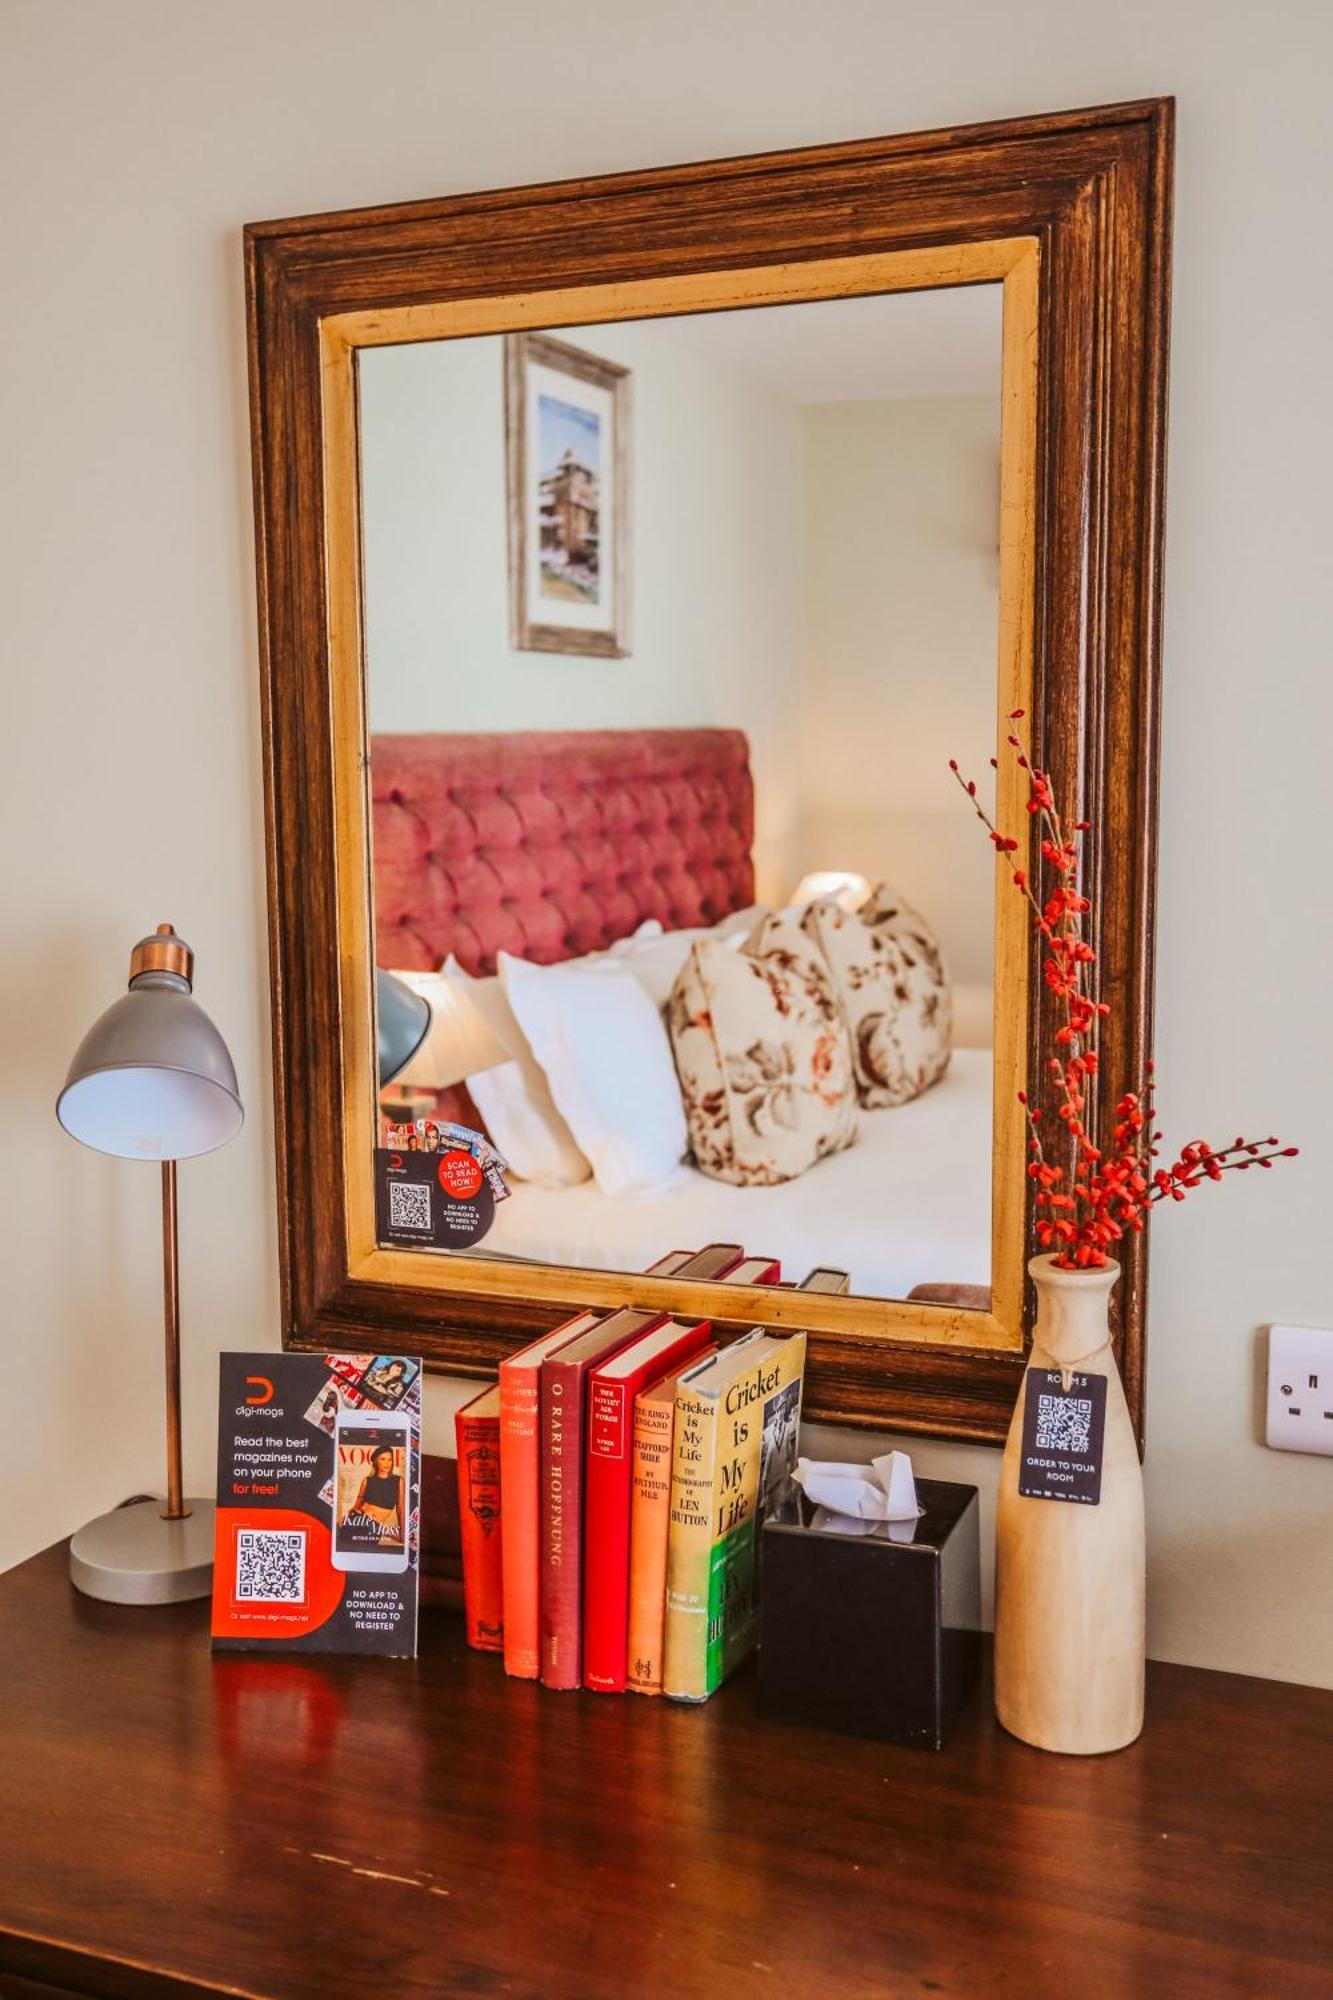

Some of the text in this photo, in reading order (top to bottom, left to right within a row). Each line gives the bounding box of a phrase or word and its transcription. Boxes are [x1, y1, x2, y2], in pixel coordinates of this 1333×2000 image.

[447, 1160, 470, 1170] SCAN
[443, 1167, 477, 1180] TO READ
[1047, 1374, 1088, 1387] ROM 5
[725, 1365, 781, 1416] Cricket
[235, 1406, 284, 1418] digi-mags
[675, 1397, 714, 1416] Cricket
[636, 1417, 668, 1429] ENGLAND
[687, 1415, 698, 1427] is
[682, 1430, 703, 1447] My
[733, 1420, 749, 1448] is
[234, 1436, 309, 1448] Read the best
[234, 1453, 318, 1464] magazines now
[679, 1446, 702, 1461] Life
[1027, 1457, 1096, 1473] ORDER TO YOUR
[234, 1468, 312, 1479] on your phone
[551, 1383, 564, 1566] O RARE HOFFNUNG
[719, 1457, 748, 1496] My
[1047, 1471, 1074, 1483] ROOM
[233, 1483, 279, 1495] for free!
[680, 1498, 699, 1511] LEN
[343, 1512, 373, 1527] Kate
[671, 1510, 709, 1526] HUTTON
[716, 1493, 749, 1537] Life
[369, 1522, 401, 1537] Moss
[353, 1590, 398, 1600] NO APP TO
[346, 1600, 405, 1610] DOWNLOAD &
[350, 1611, 401, 1621] NO NEED TO
[355, 1621, 394, 1630] REGISTER
